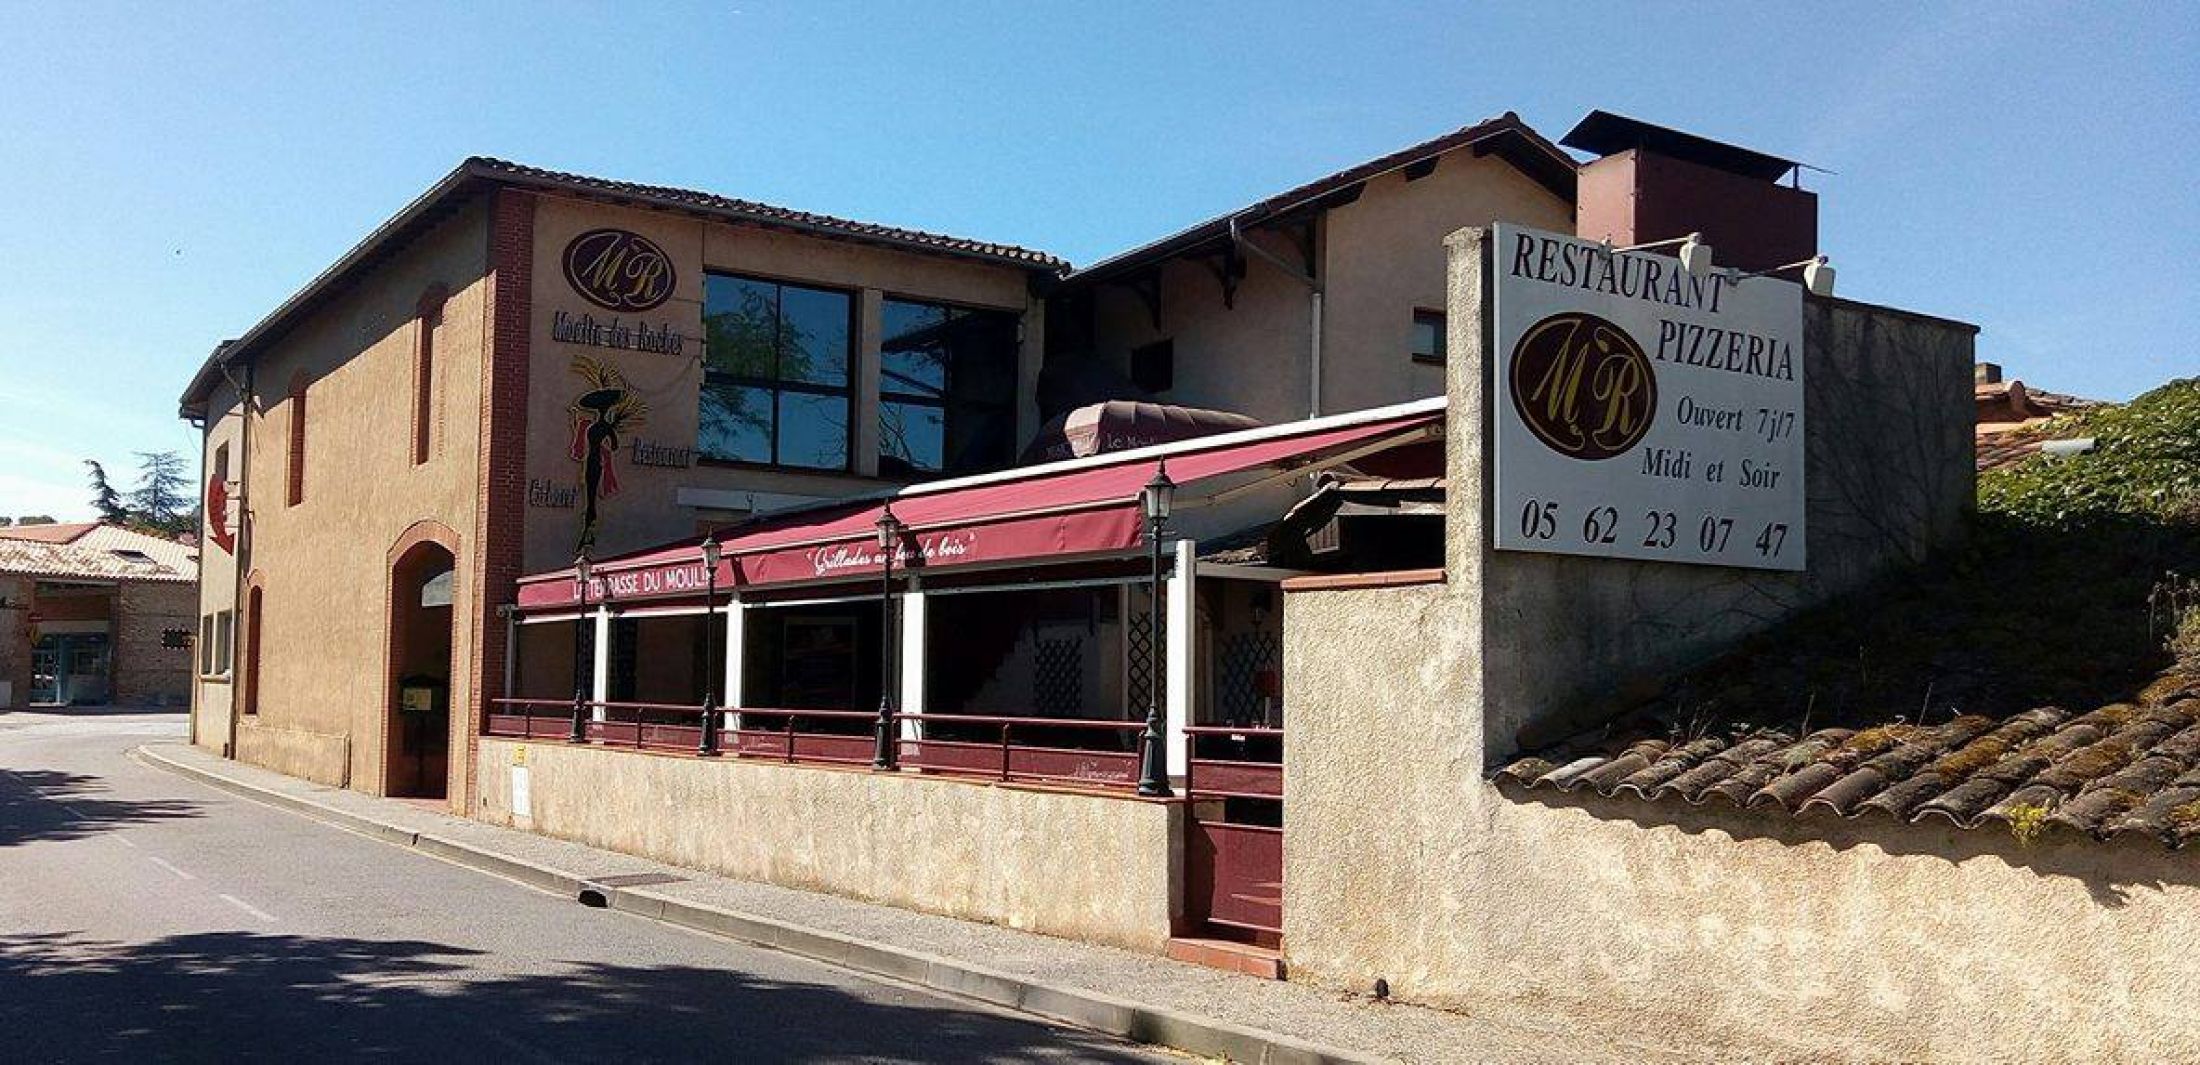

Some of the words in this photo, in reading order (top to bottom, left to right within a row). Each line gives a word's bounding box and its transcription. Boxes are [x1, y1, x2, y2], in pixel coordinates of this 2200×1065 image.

[1511, 232, 1727, 313] RESTAURANT
[1656, 319, 1795, 382] PIZZERIA
[1519, 315, 1648, 450] MR
[1677, 395, 1743, 431] Ouvert
[1758, 408, 1795, 443] 7j/7
[1642, 448, 1692, 480] Midi
[1706, 460, 1725, 483] et
[1739, 458, 1781, 490] Soir
[1520, 499, 1559, 541] 05
[1583, 506, 1618, 544] 62
[1643, 510, 1678, 549] 23
[1700, 515, 1734, 553] 07
[1755, 523, 1788, 558] 47
[643, 569, 661, 593] DU
